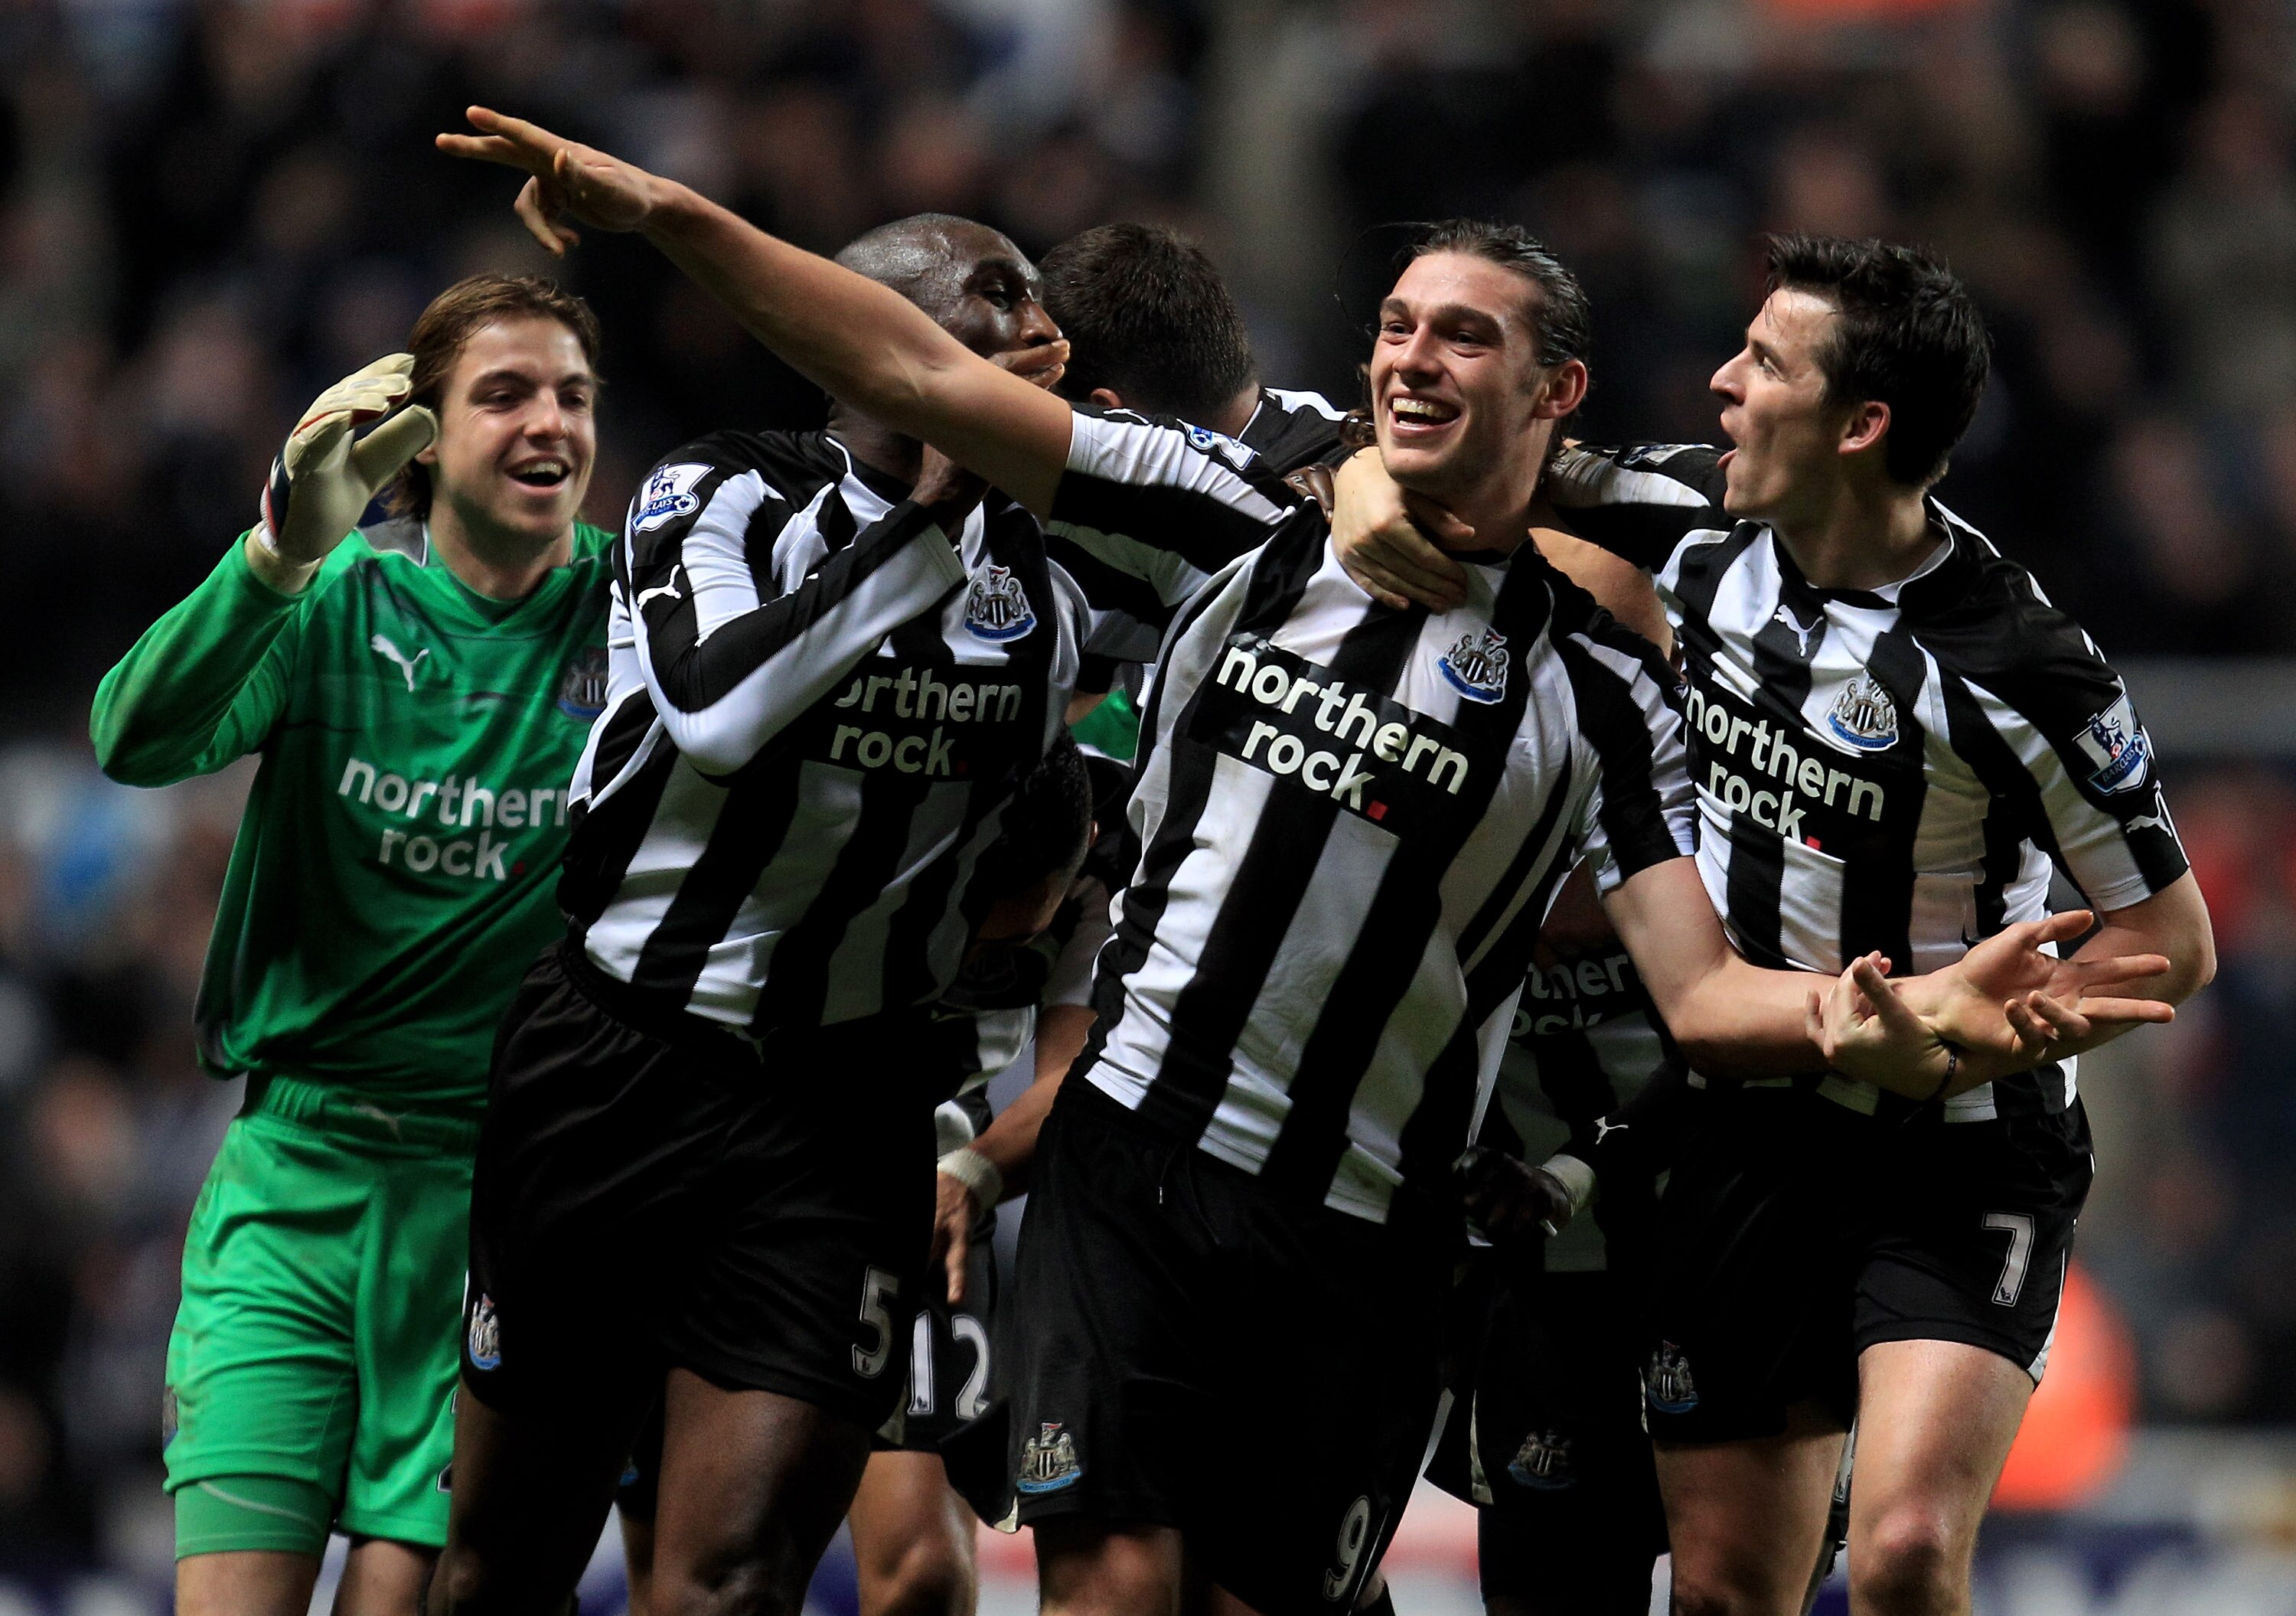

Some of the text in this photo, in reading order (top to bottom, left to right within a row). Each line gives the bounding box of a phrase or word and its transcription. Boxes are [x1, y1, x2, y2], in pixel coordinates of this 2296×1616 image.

[1217, 646, 1469, 795] northern
[1686, 684, 1884, 821] northern
[1981, 1210, 2035, 1307] 7
[852, 1265, 902, 1379] 5
[907, 1308, 990, 1420] 12
[1322, 1495, 1371, 1602] 9
